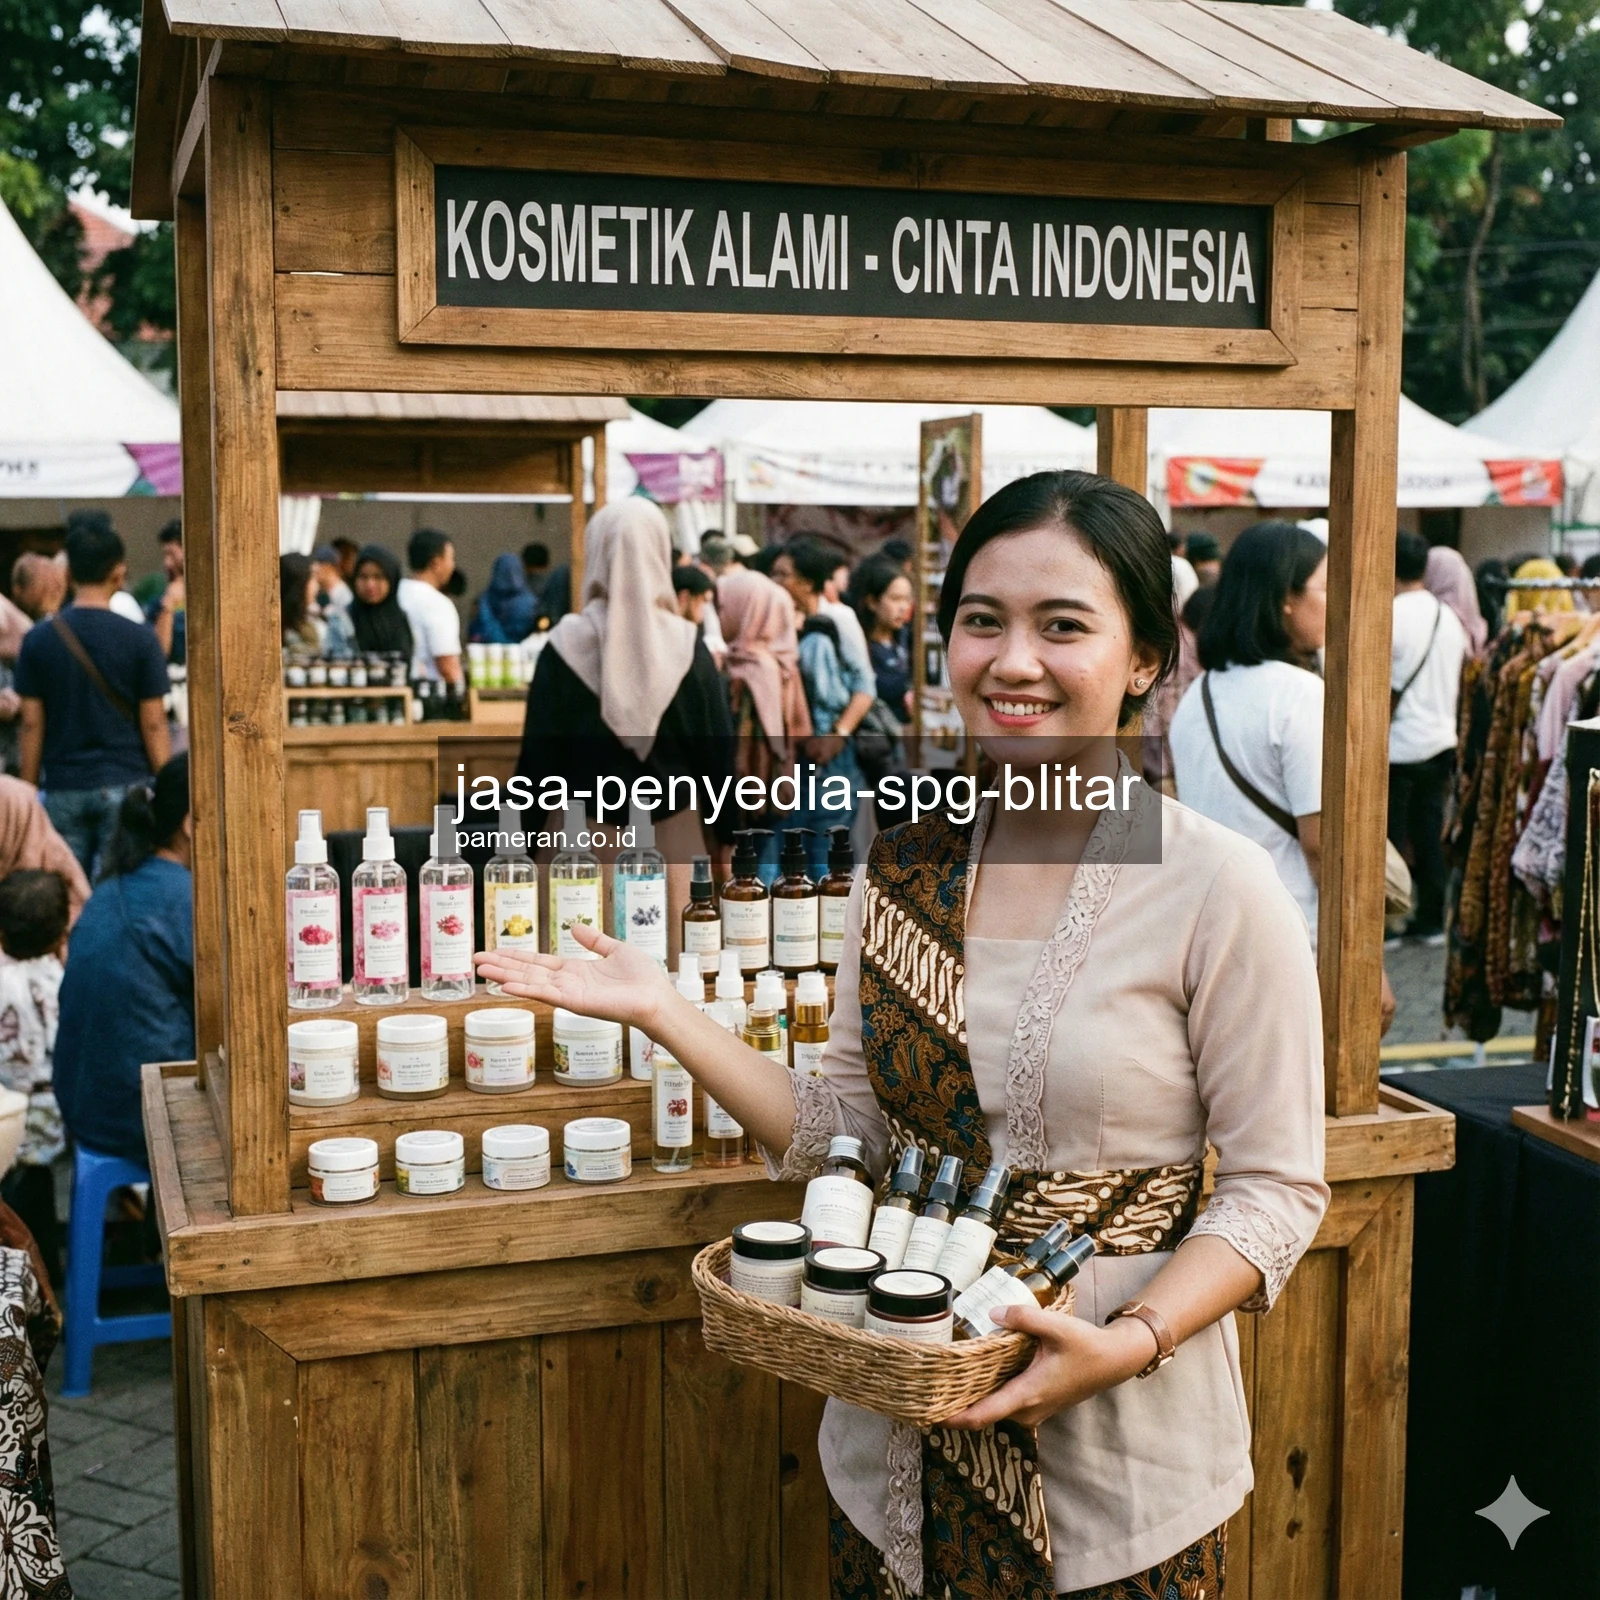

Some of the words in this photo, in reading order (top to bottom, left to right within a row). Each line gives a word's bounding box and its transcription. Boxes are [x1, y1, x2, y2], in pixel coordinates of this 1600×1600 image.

[447, 199, 695, 286] KOSMETIK
[706, 210, 849, 291] ALAMI
[865, 255, 878, 270] -
[892, 216, 1019, 297] CINTA
[1032, 223, 1256, 304] INDONESIA
